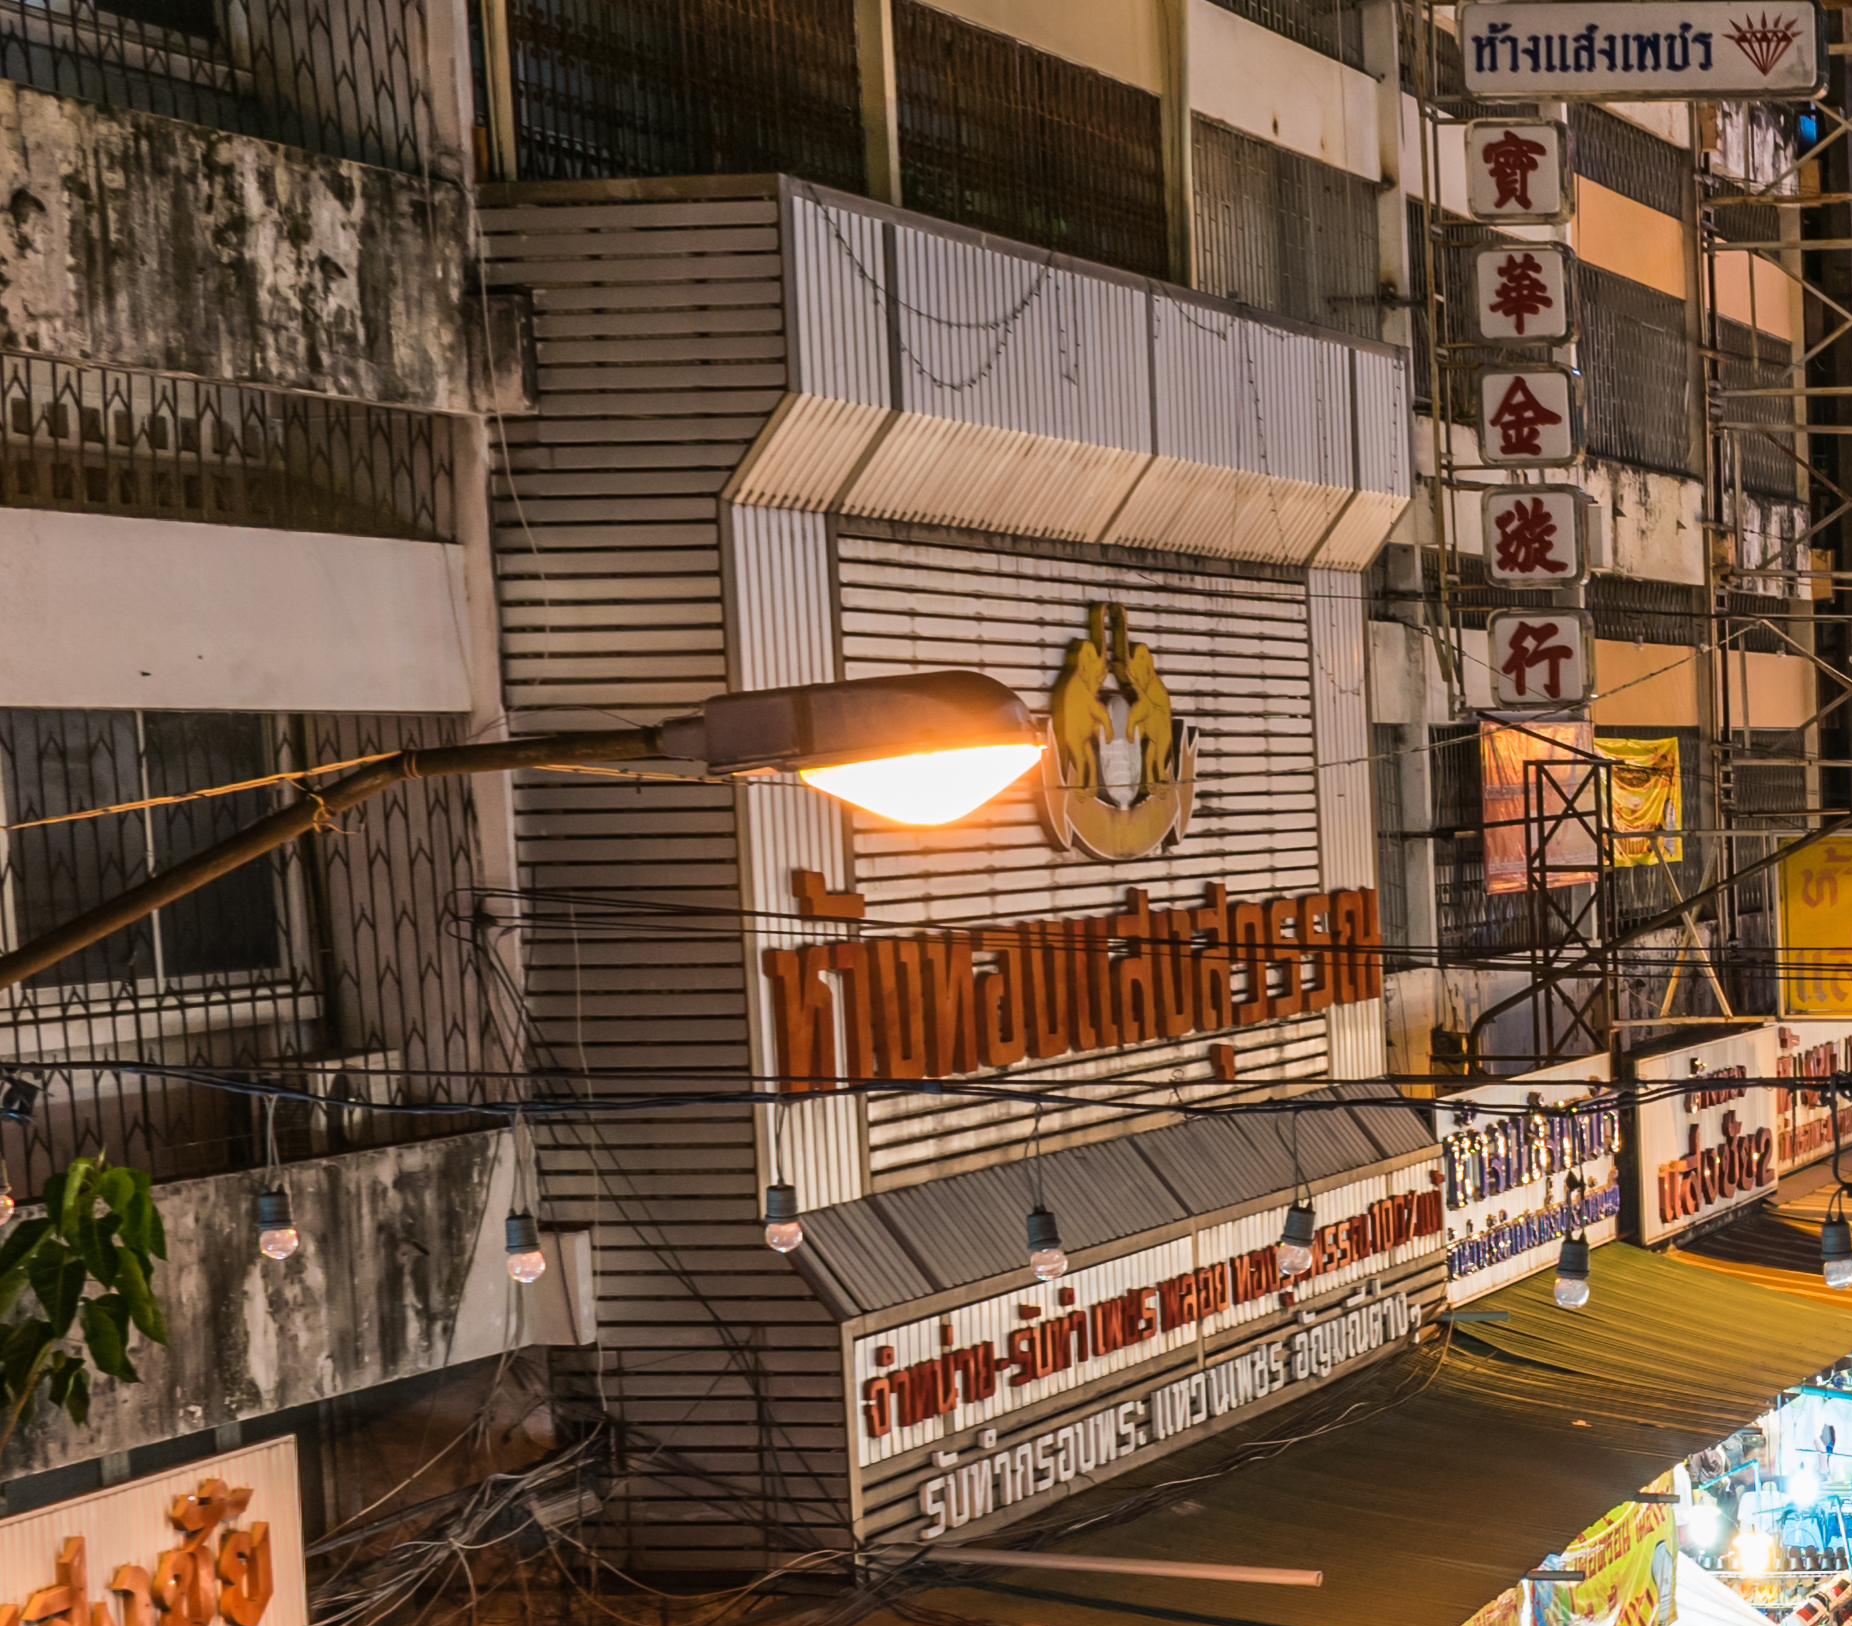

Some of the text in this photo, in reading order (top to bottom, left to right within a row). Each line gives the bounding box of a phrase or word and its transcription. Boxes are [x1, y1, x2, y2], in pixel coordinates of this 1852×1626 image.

[1471, 21, 1713, 73] ห้างแสงเพชร
